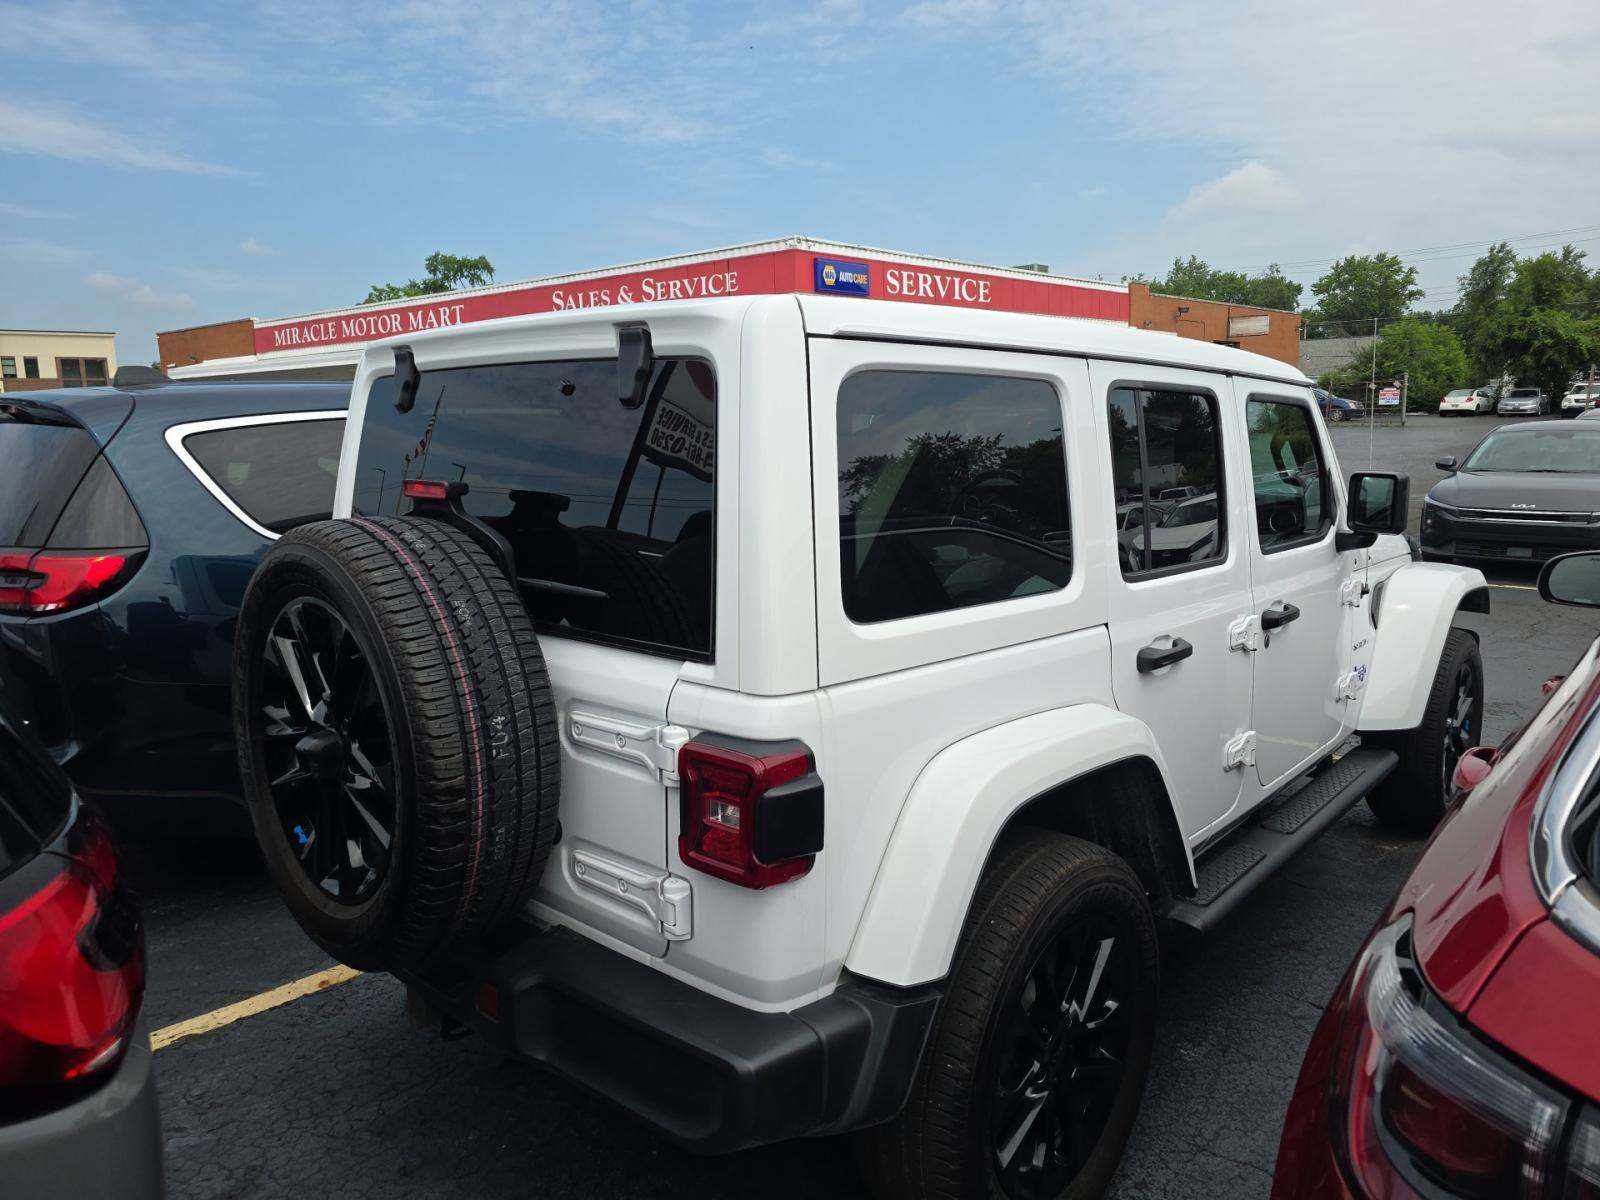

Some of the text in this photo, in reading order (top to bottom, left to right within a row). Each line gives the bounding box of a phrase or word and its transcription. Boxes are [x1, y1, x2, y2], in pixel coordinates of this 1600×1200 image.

[552, 272, 739, 312] SALES & SERVICE
[886, 269, 992, 303] SERVICE
[274, 304, 465, 347] MIRACLE MOTOR MART
